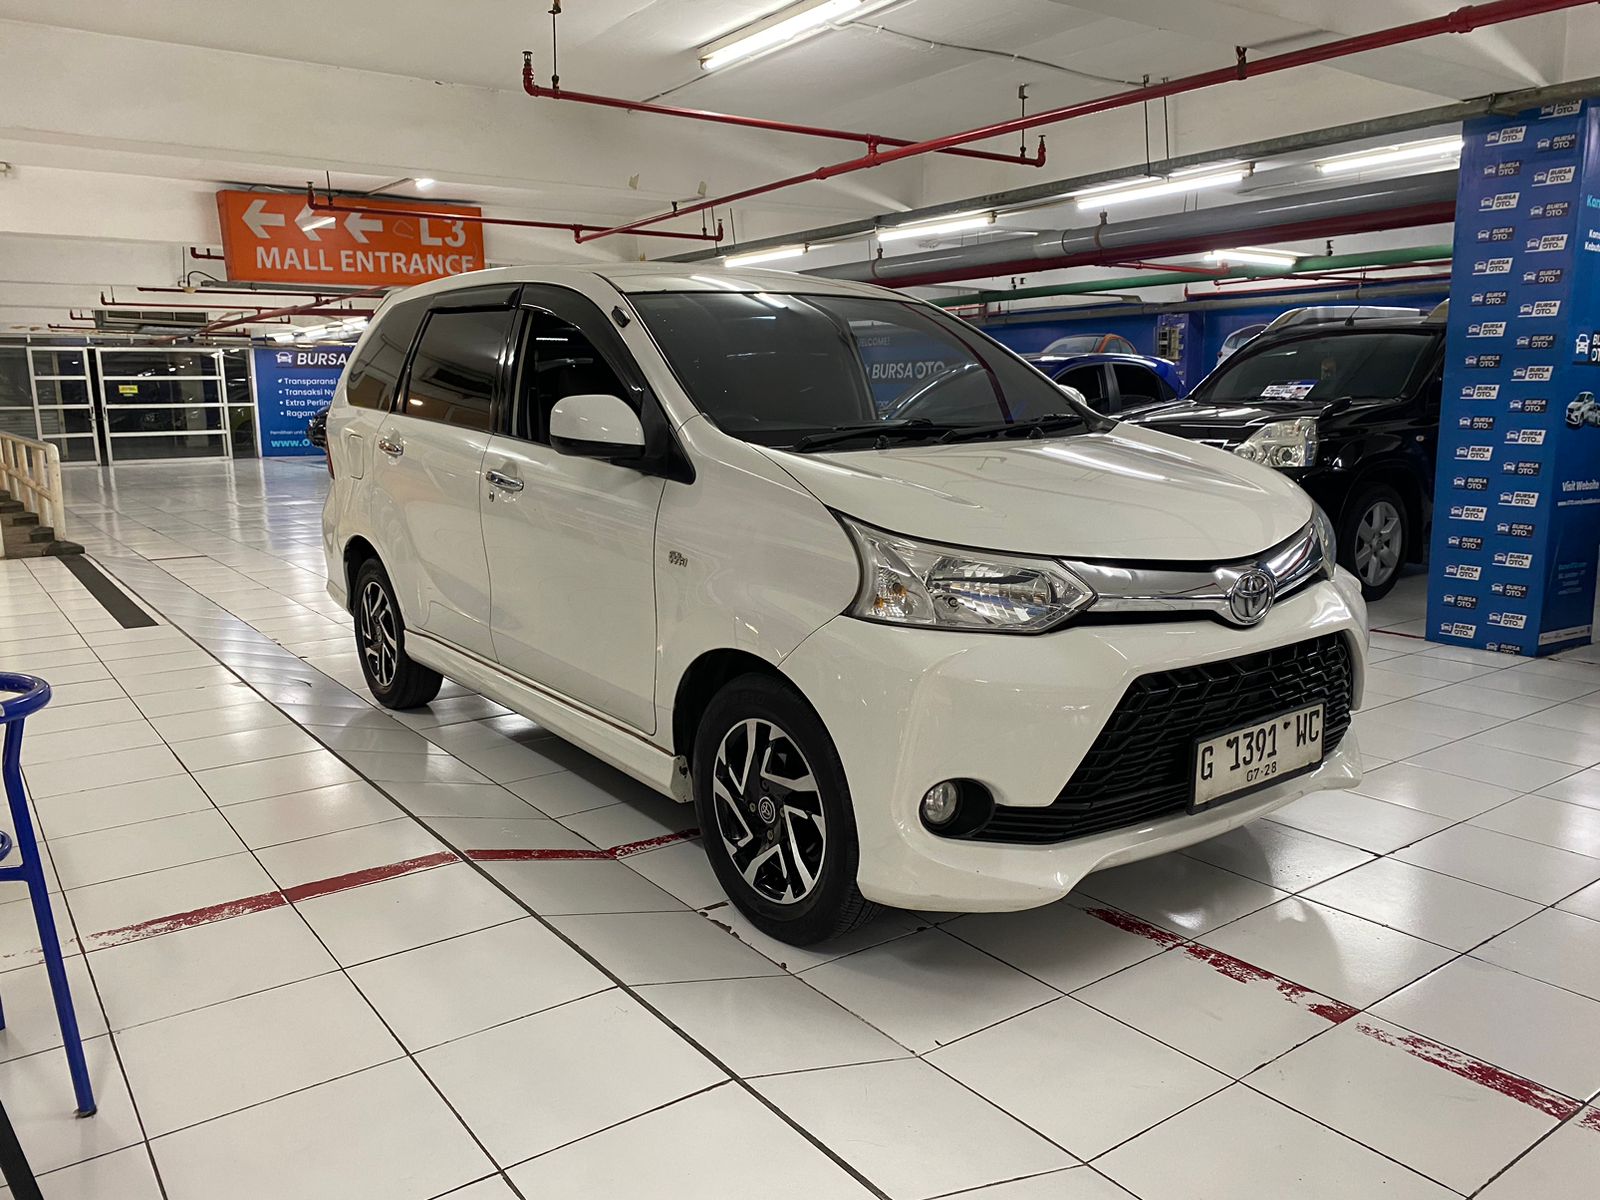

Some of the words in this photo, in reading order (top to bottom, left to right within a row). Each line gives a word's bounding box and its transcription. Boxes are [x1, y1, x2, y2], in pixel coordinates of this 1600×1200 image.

[419, 214, 467, 247] L3
[256, 246, 335, 272] MALL
[340, 250, 474, 275] ENTRANCE
[297, 353, 347, 365] BURSA
[872, 363, 913, 379] BURSA
[284, 377, 336, 387] Transparansi
[285, 388, 323, 396] Transaksi
[1201, 745, 1214, 780] G
[1229, 723, 1277, 771] 1391
[1296, 709, 1320, 747] WC
